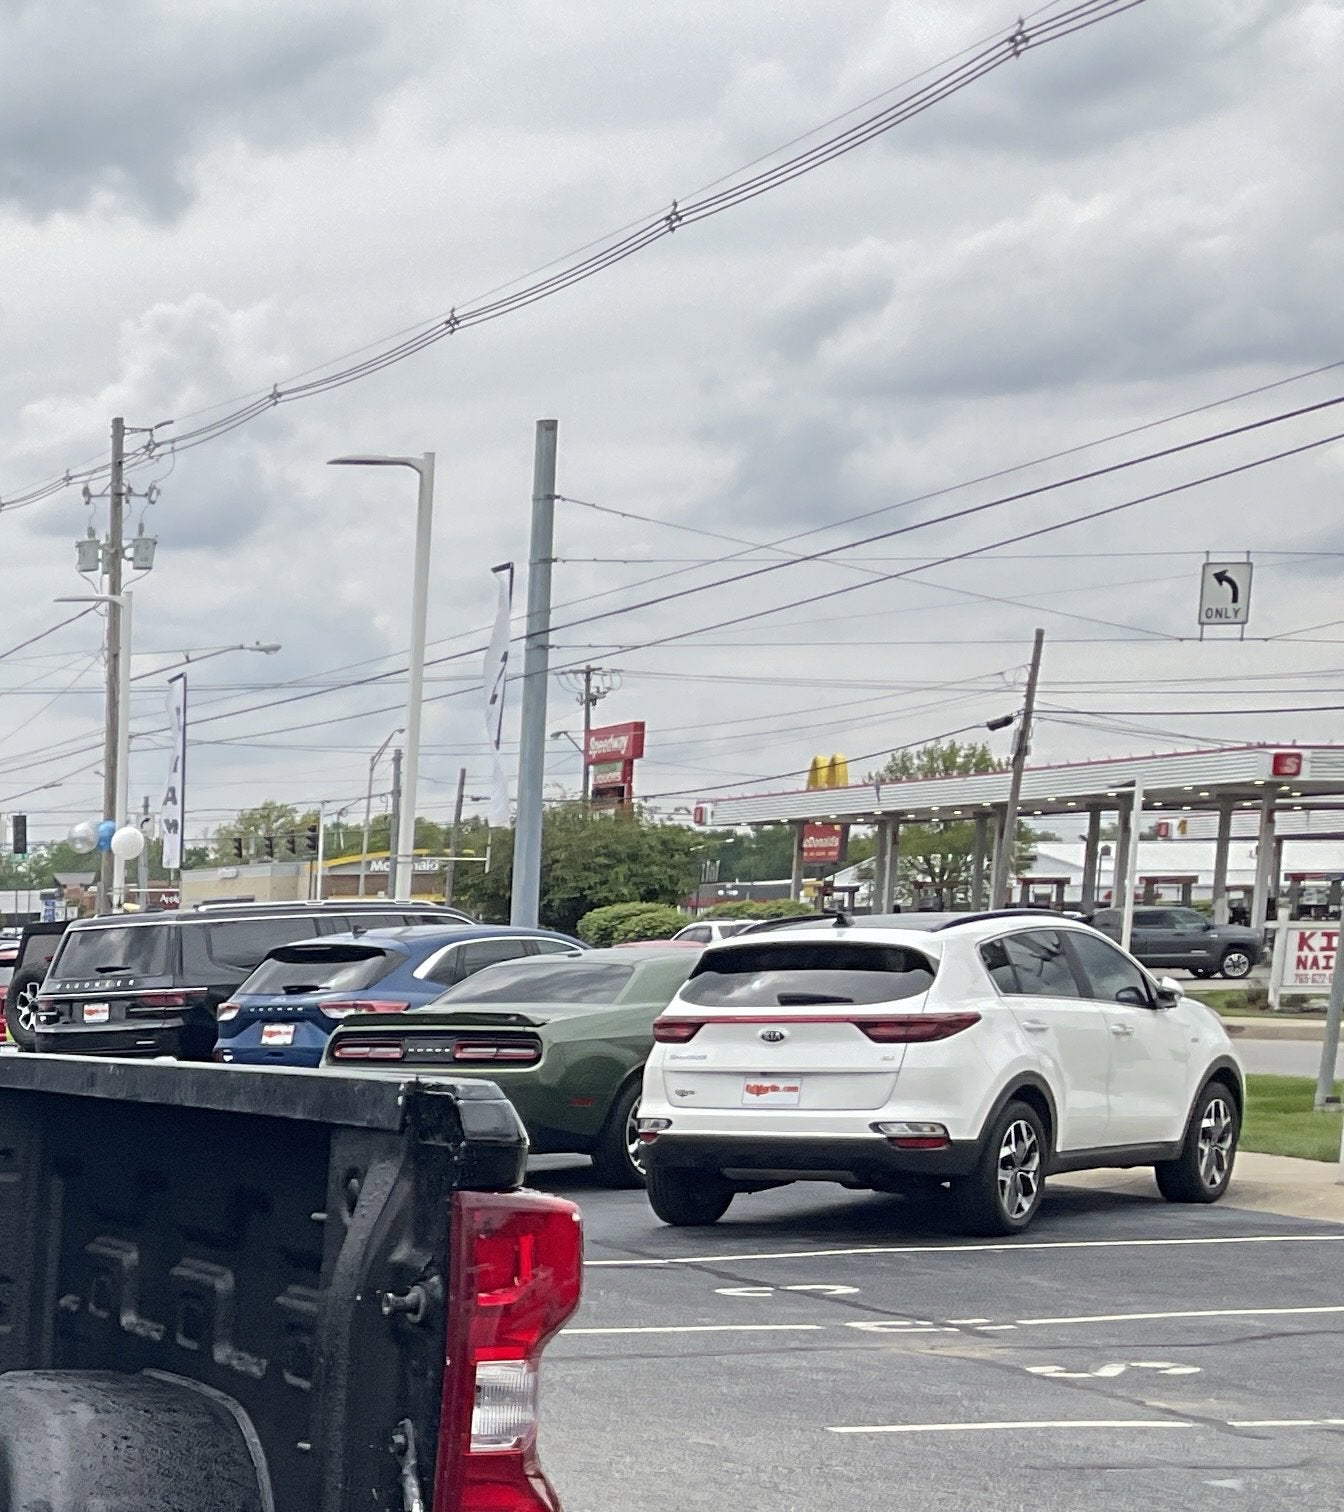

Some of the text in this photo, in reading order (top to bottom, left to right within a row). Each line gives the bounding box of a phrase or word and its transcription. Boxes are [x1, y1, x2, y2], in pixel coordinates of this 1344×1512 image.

[1205, 607, 1241, 619] ONLY
[1298, 931, 1340, 952] KI
[1296, 955, 1334, 970] NAI
